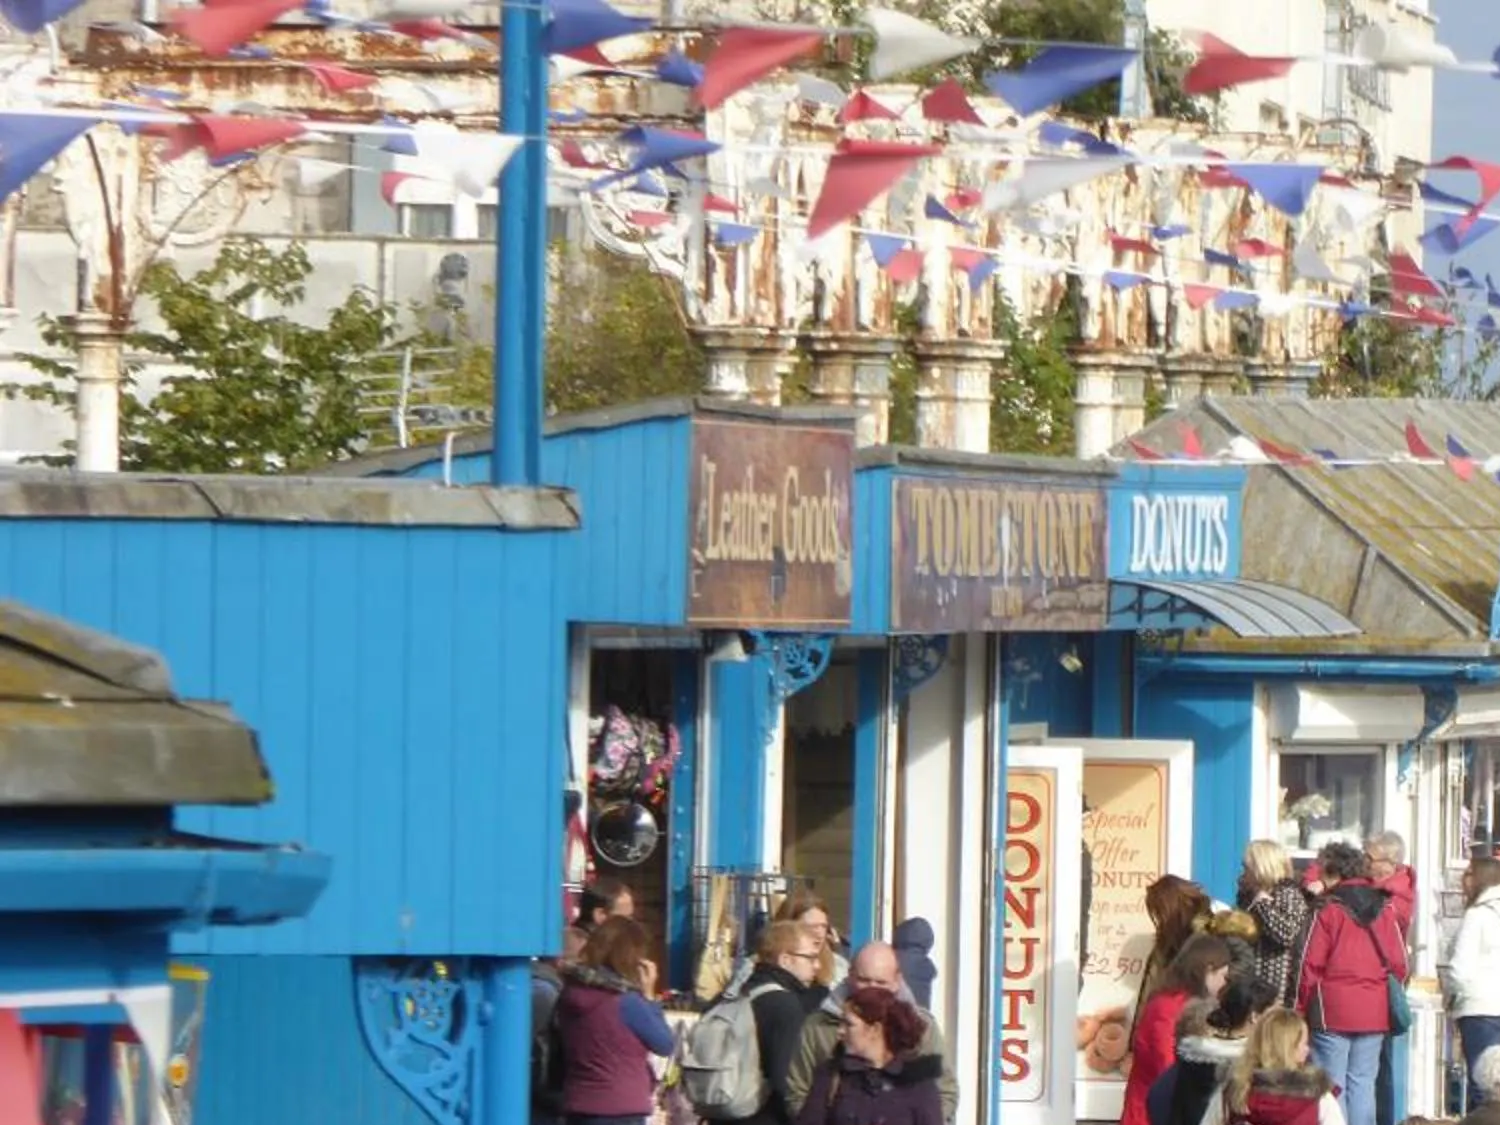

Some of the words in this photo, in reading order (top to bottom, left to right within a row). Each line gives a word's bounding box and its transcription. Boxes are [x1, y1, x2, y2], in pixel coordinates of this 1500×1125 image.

[706, 462, 777, 561] Leather
[781, 465, 840, 563] Goods
[1130, 494, 1229, 575] DONUTS
[1091, 870, 1158, 889] ONUTS
